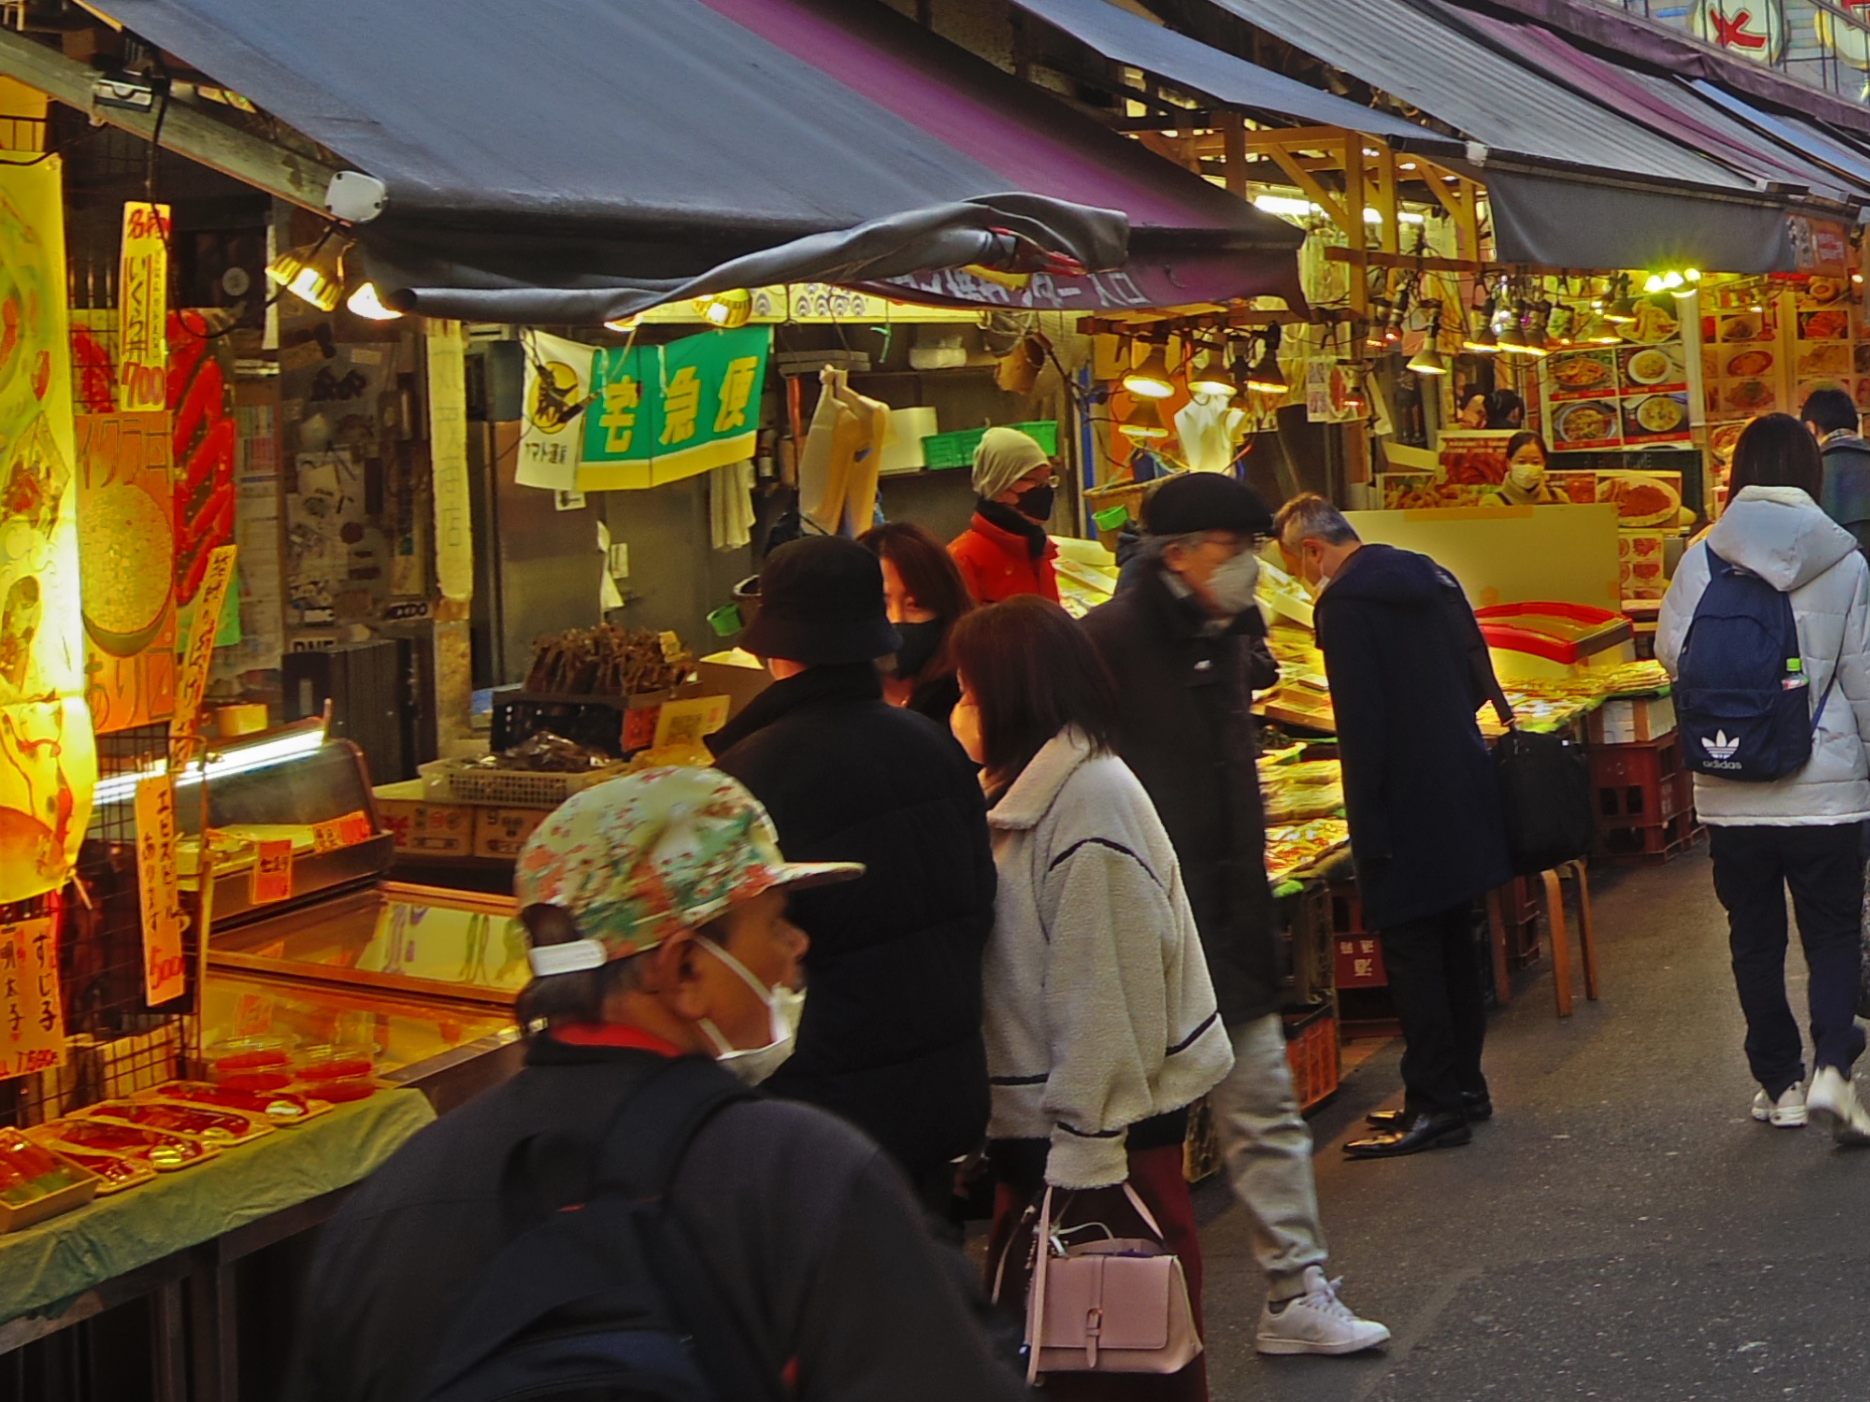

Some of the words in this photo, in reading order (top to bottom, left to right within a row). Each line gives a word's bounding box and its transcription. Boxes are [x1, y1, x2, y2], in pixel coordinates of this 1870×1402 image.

[598, 355, 760, 454] 宅急便
[1703, 759, 1742, 769] adidas
[32, 933, 57, 1032] すじ子
